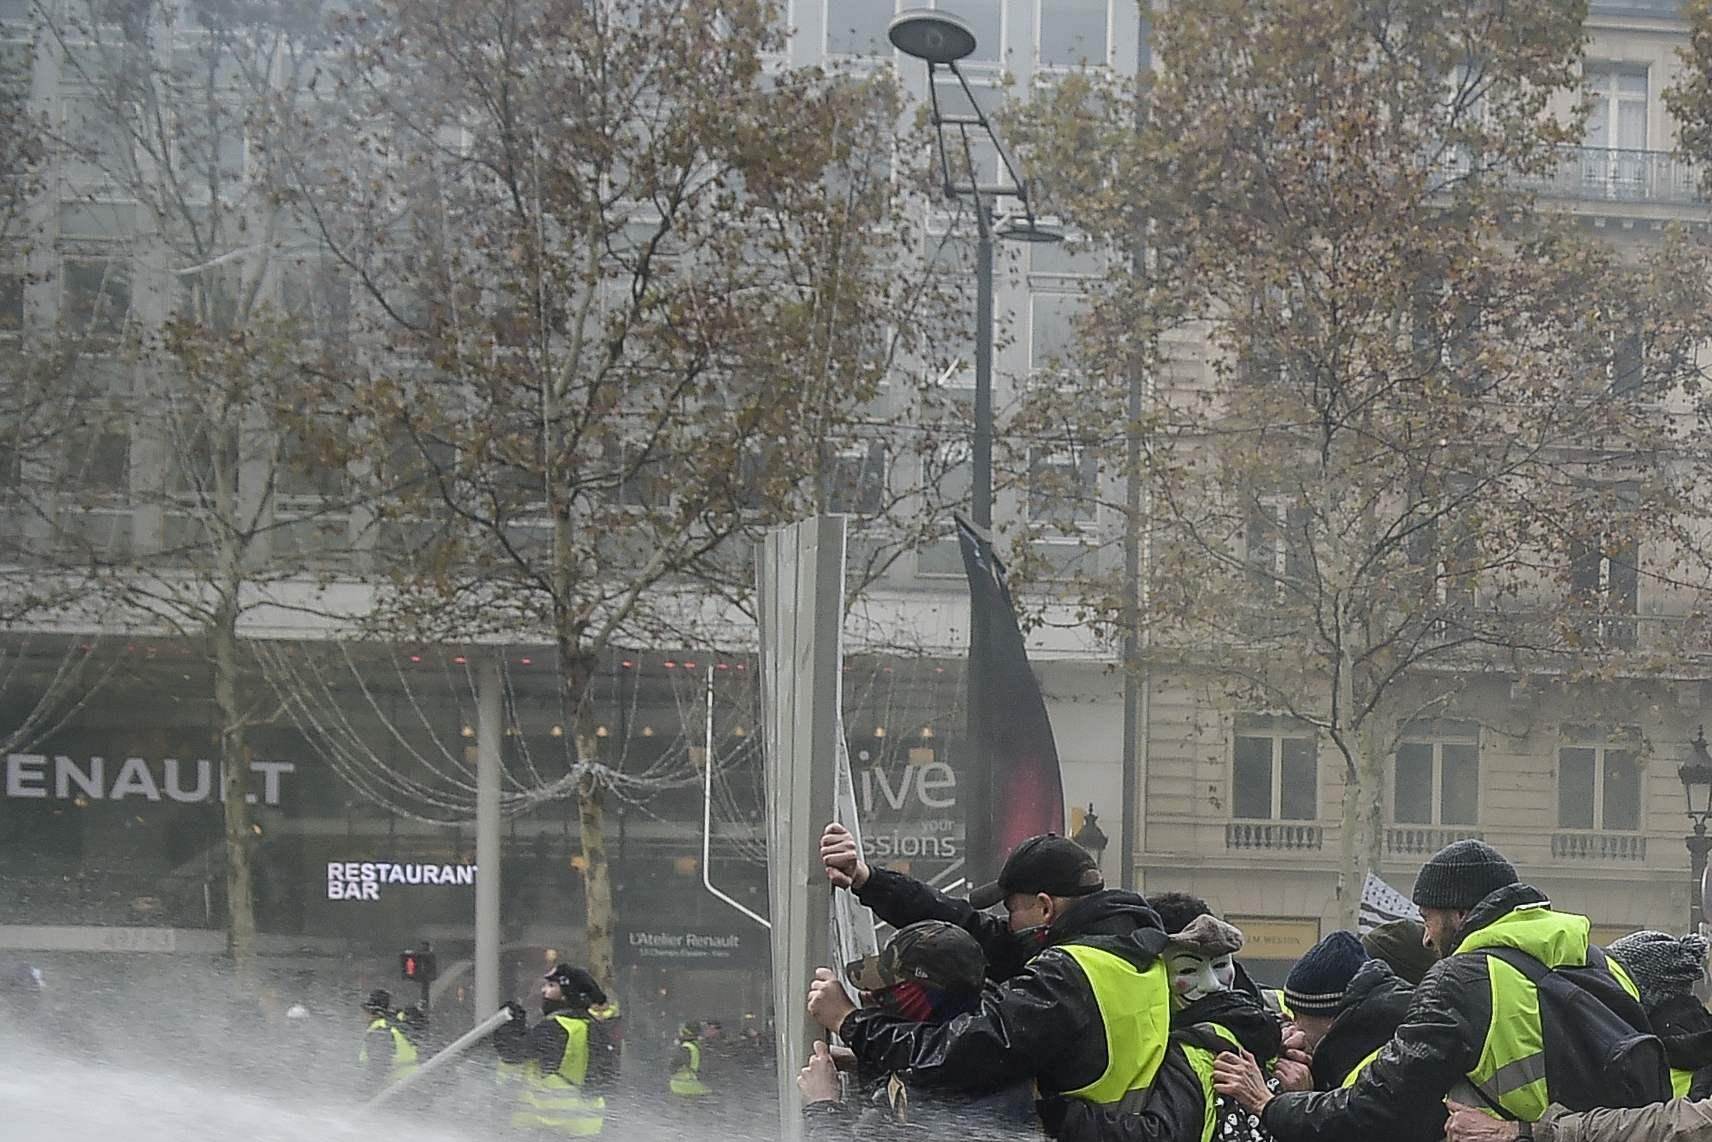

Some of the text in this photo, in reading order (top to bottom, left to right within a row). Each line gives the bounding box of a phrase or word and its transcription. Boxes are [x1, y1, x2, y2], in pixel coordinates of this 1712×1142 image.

[327, 862, 479, 884] RESTAURAN
[327, 881, 380, 900] BAR
[686, 933, 739, 947] Renault
